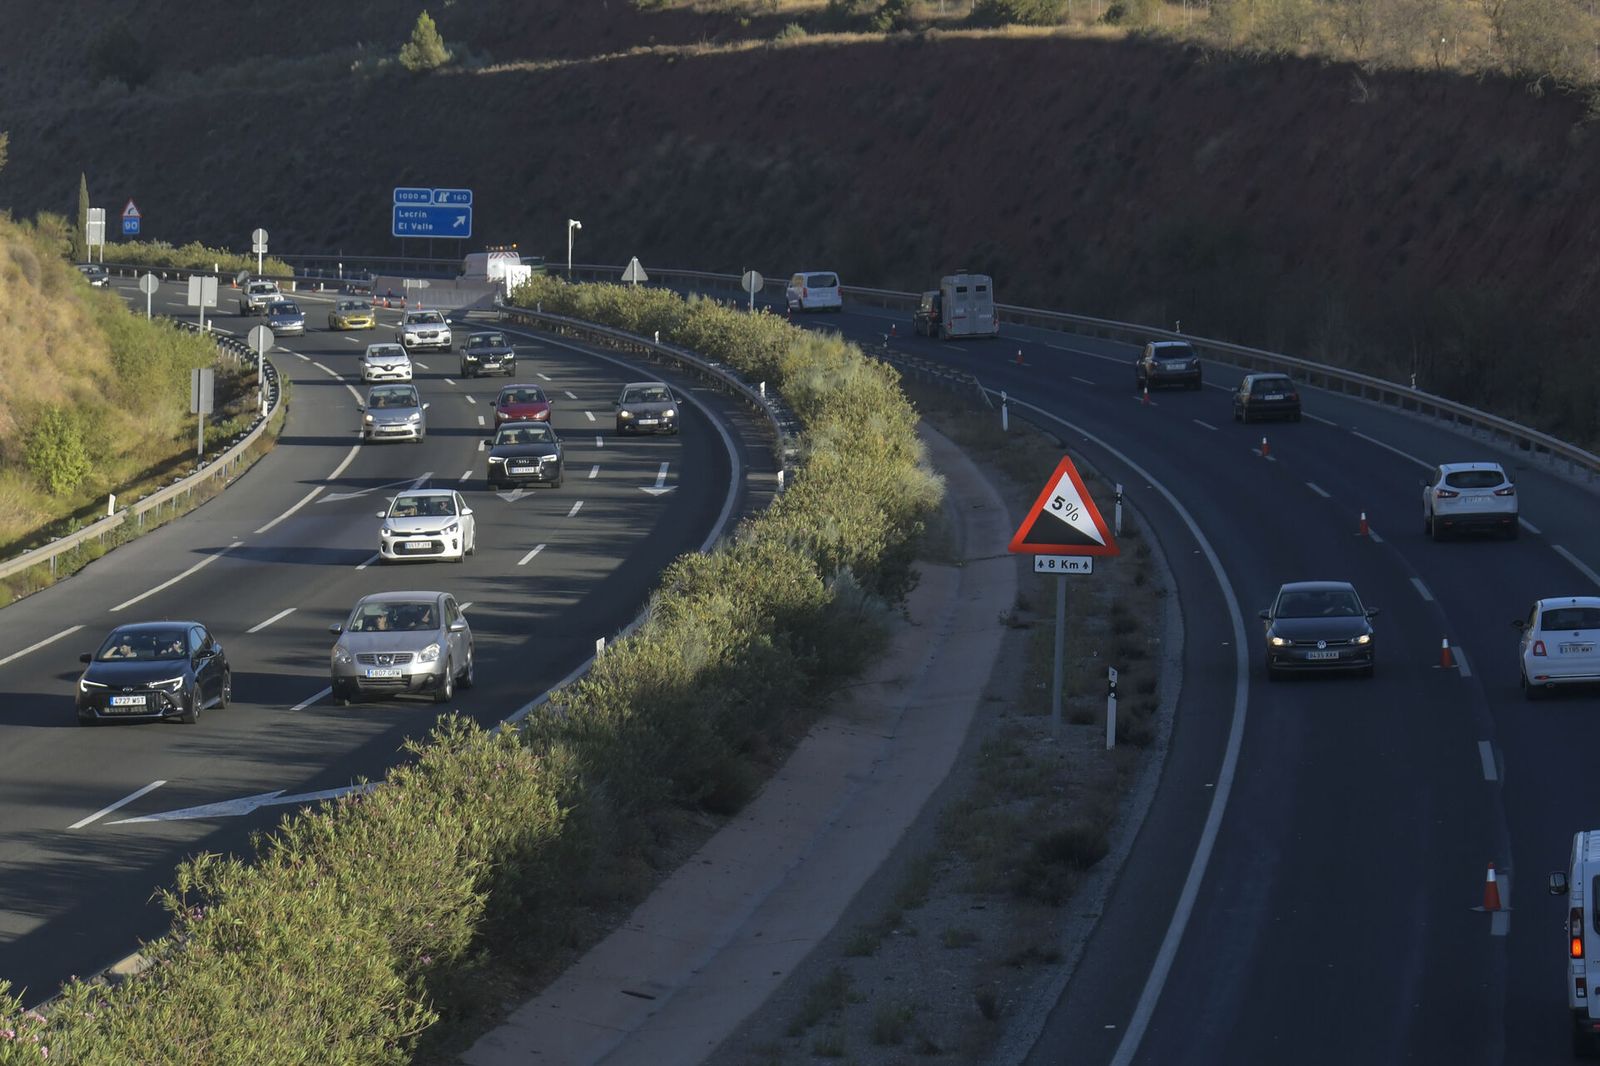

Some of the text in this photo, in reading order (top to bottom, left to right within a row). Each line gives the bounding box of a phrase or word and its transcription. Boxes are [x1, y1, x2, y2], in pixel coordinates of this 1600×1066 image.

[125, 221, 138, 230] 90
[398, 222, 433, 230] El Valle
[1051, 494, 1079, 522] 5%
[1048, 559, 1079, 570] 8 Km
